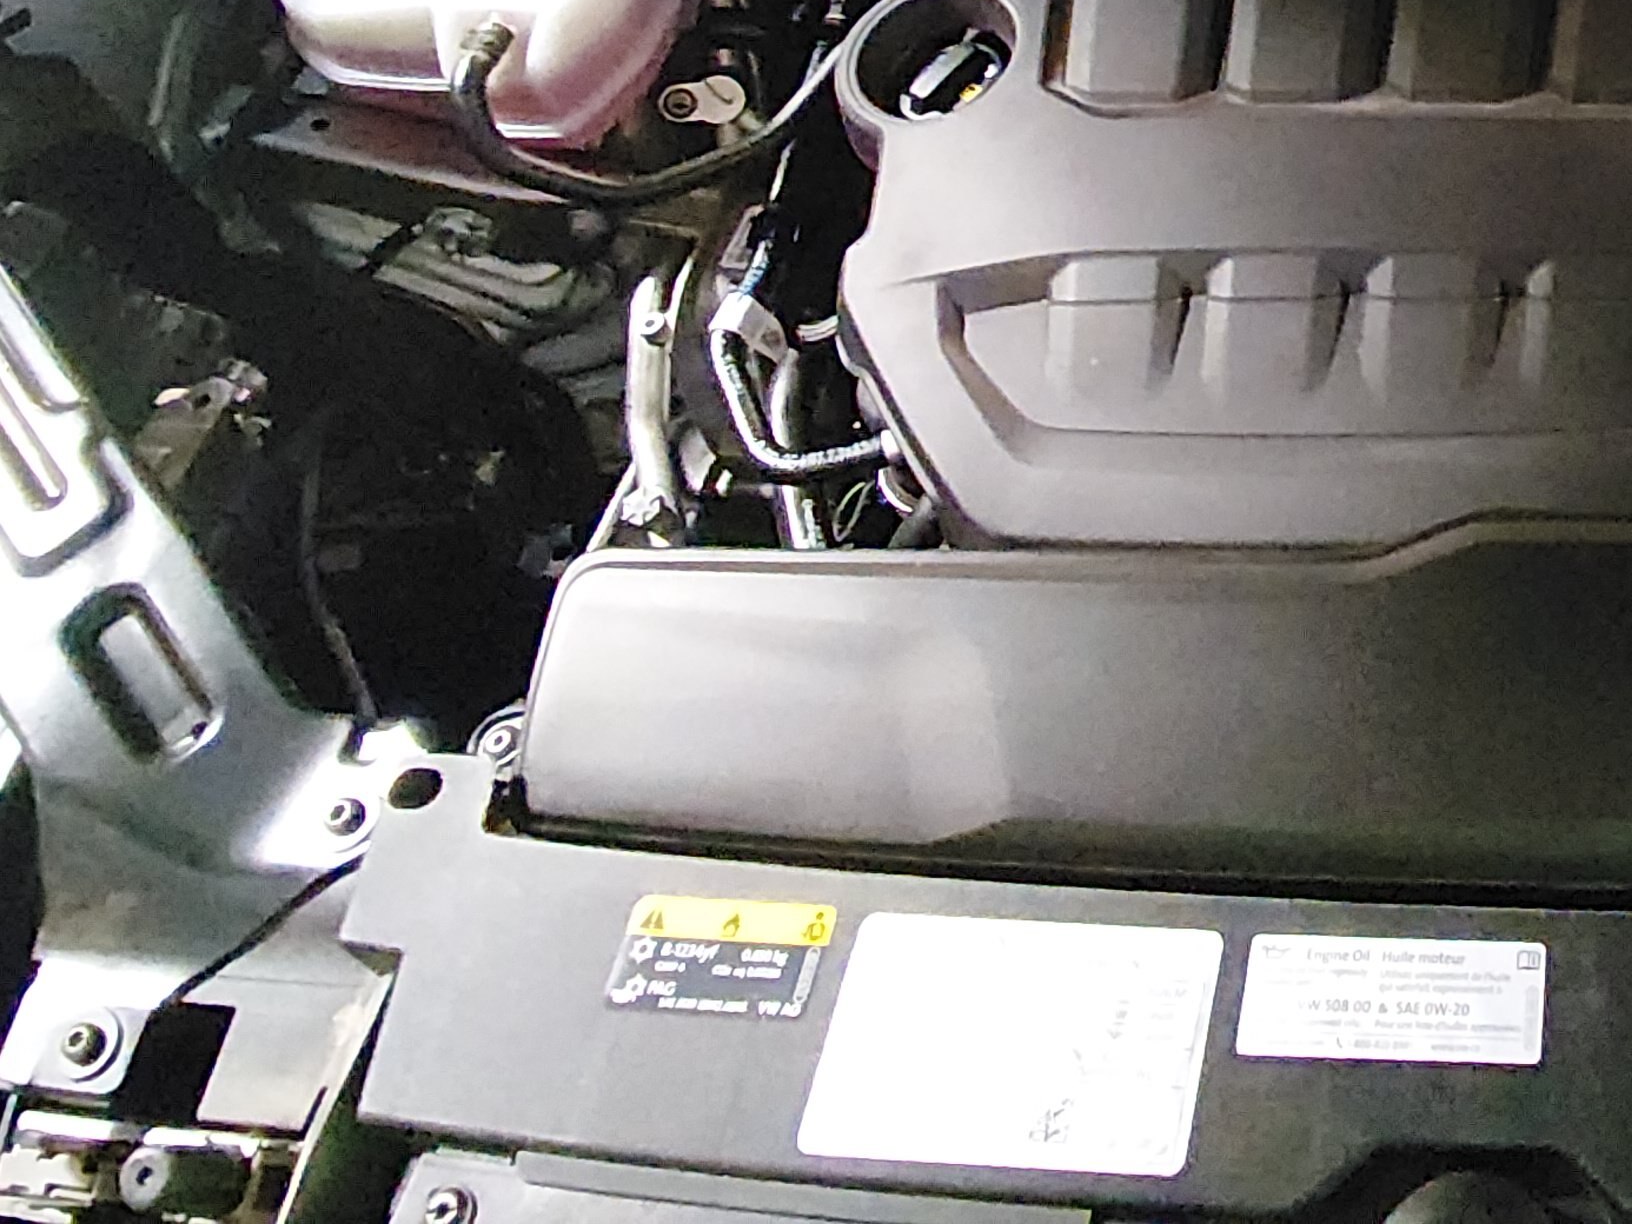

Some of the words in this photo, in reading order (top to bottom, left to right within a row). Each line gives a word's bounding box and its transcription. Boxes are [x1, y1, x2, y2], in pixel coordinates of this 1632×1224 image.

[1352, 949, 1371, 963] Oil
[1382, 951, 1416, 964] Huile
[1418, 953, 1466, 965] moteur
[1325, 999, 1350, 1014] 508
[1352, 1000, 1372, 1014] 00
[1396, 1001, 1421, 1015] SAE
[1424, 1002, 1471, 1017] 0W-20
